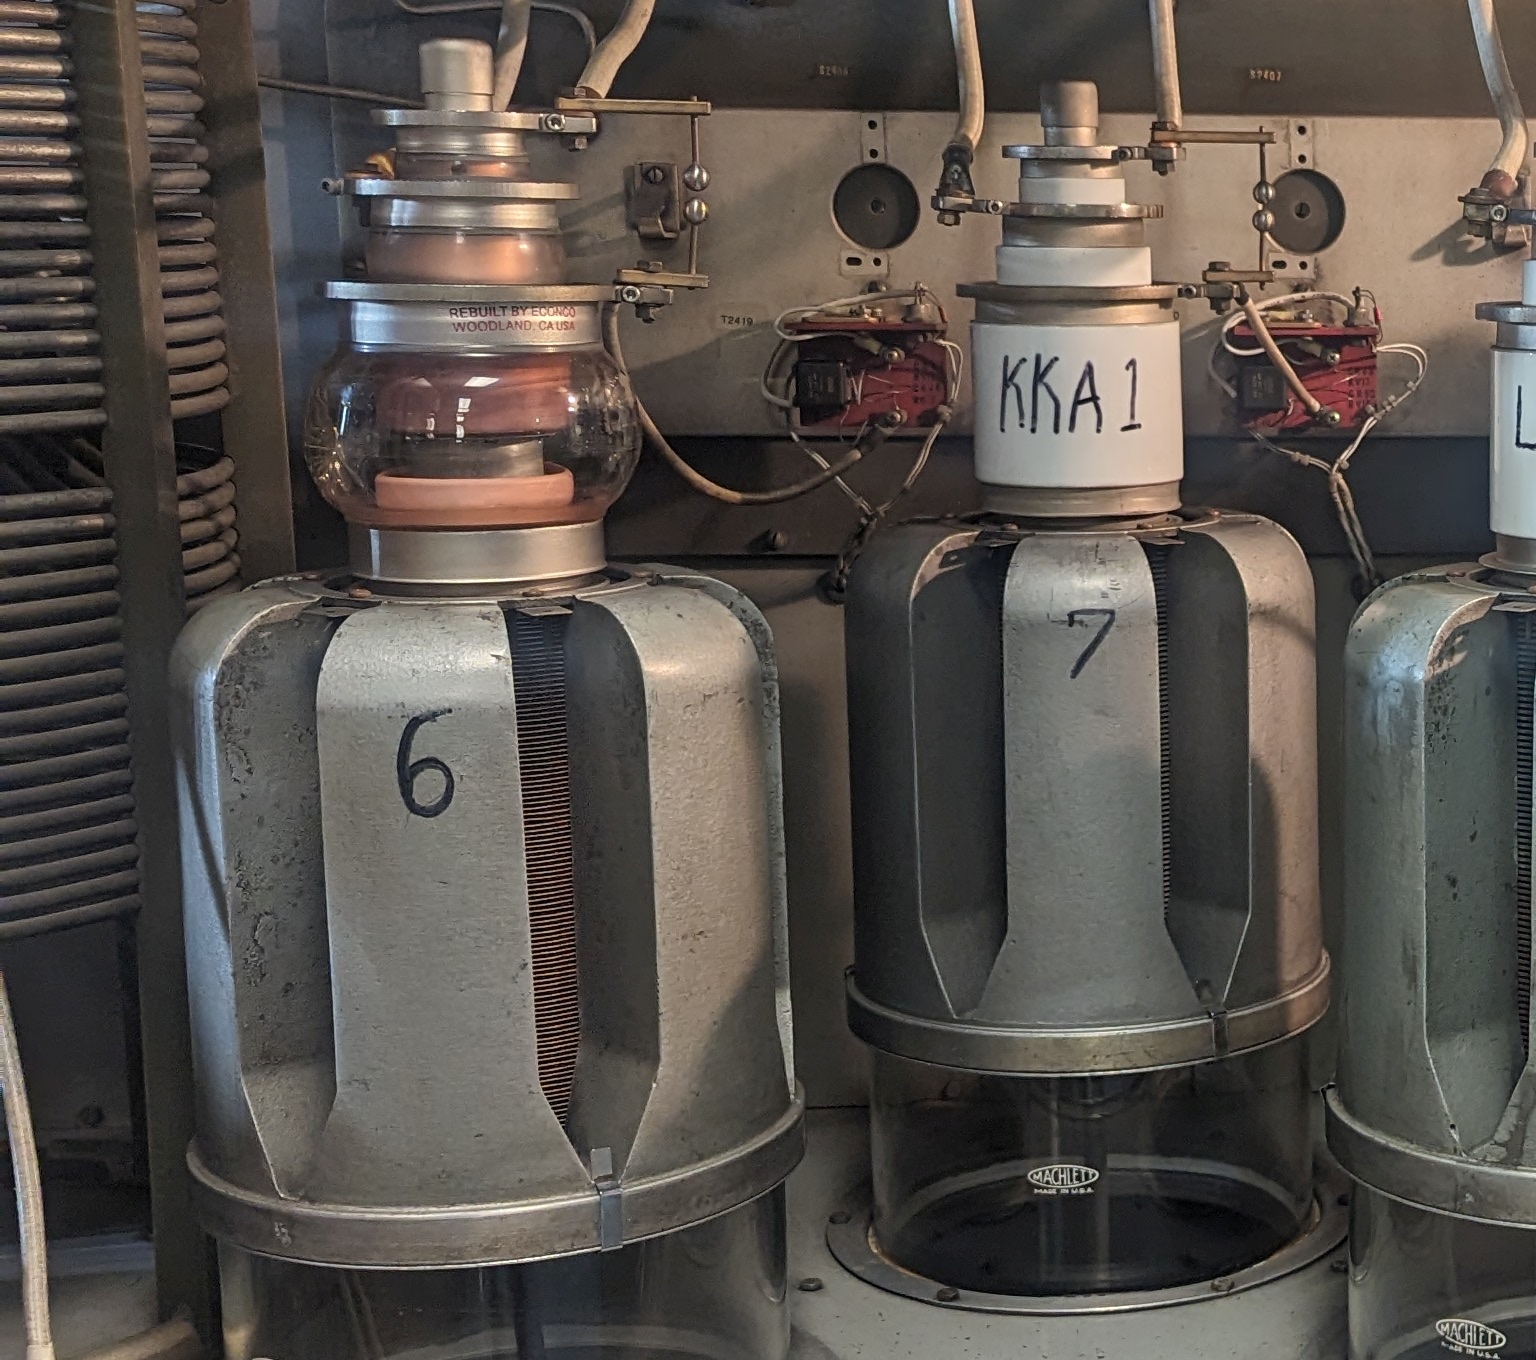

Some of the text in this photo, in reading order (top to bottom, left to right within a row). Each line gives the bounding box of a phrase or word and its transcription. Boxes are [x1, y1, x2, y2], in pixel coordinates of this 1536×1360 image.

[449, 305, 576, 319] REBUILT BY ECONCO
[539, 321, 554, 331] CA
[556, 321, 576, 331] USA
[1067, 608, 1116, 680] 7
[396, 707, 454, 818] 6
[1032, 1167, 1095, 1185] MACHLETT
[1440, 1322, 1501, 1346] MACHLETT
